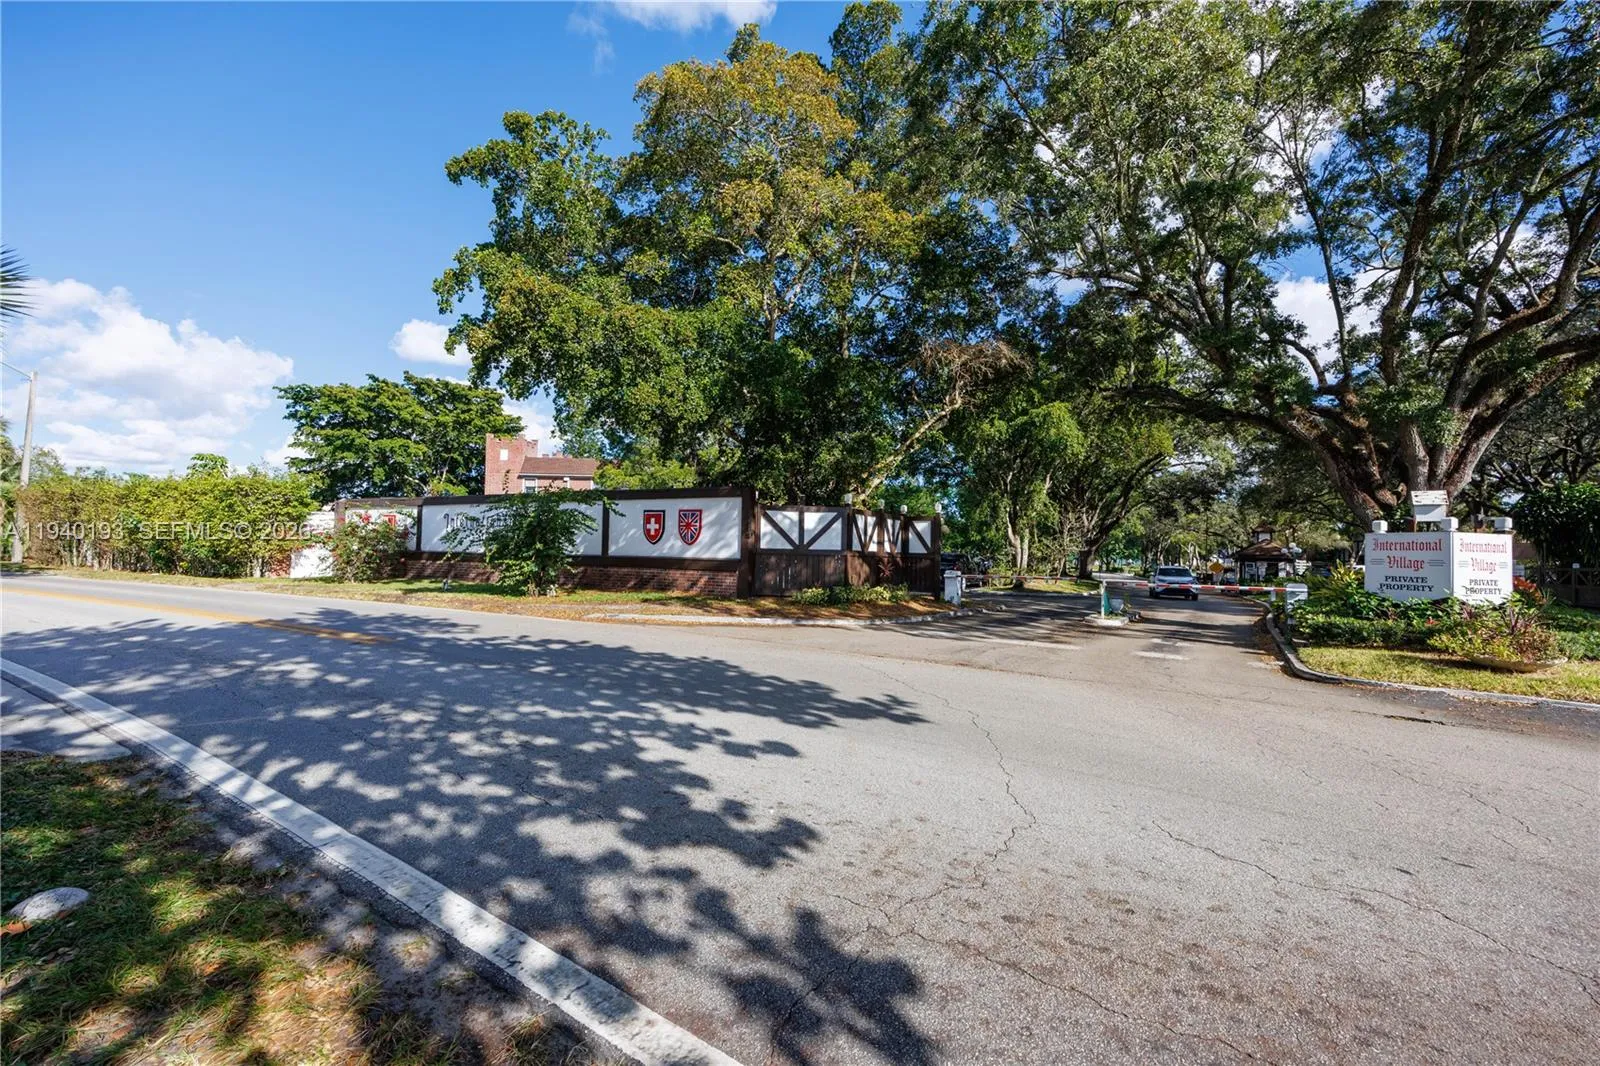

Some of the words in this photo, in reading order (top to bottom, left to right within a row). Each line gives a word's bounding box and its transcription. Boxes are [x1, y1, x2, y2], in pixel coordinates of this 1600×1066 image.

[1372, 538, 1443, 552] International
[1459, 538, 1508, 554] International
[1386, 555, 1425, 572] Village
[1470, 557, 1497, 574] Village
[1384, 575, 1428, 584] PRIVATE
[1469, 579, 1499, 587] PRIVATE
[1379, 582, 1435, 592] PROPERTY
[1464, 586, 1503, 596] PROPERTY
